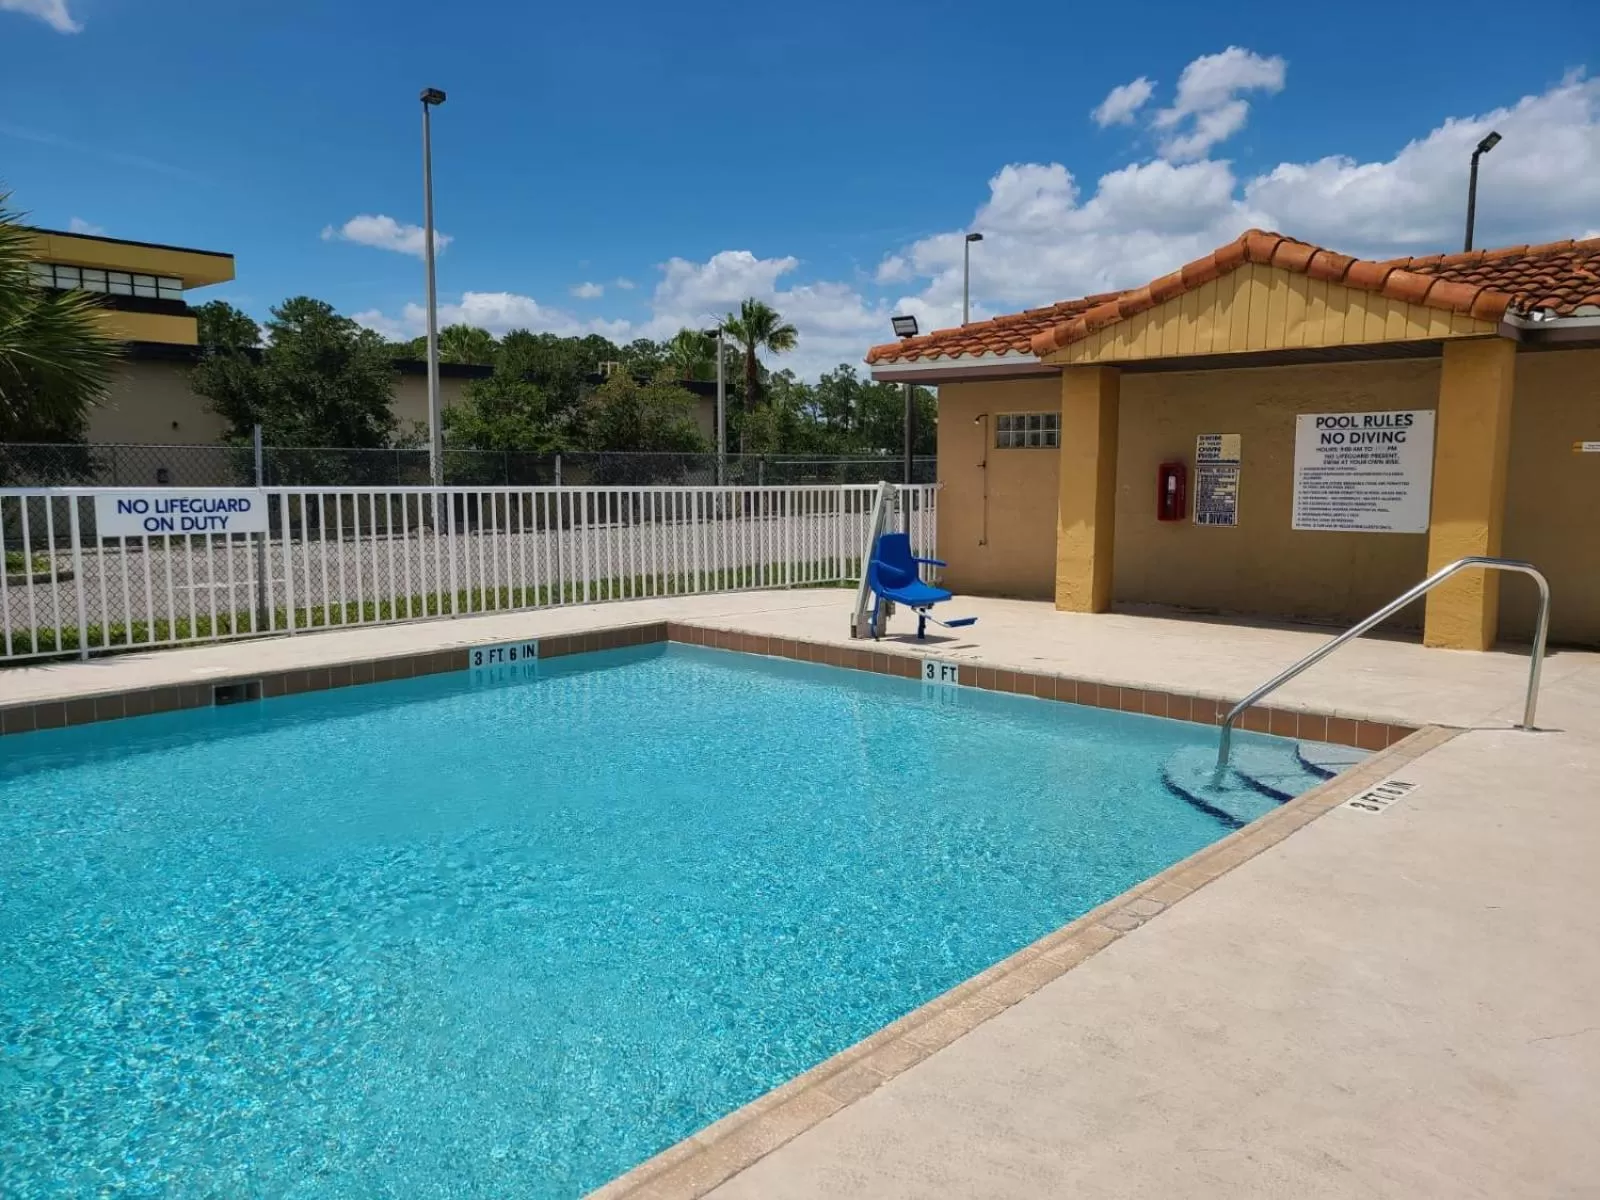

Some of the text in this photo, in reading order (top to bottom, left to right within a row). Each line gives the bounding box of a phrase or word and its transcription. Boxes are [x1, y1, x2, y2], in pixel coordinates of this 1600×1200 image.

[1316, 414, 1414, 428] POOL RULES
[1320, 431, 1406, 445] NO DIVING
[117, 498, 251, 514] NO LIFEGUARD
[143, 515, 229, 532] ON DUTY
[475, 643, 535, 665] 3 FT 6 IN
[927, 664, 957, 682] 3 FT
